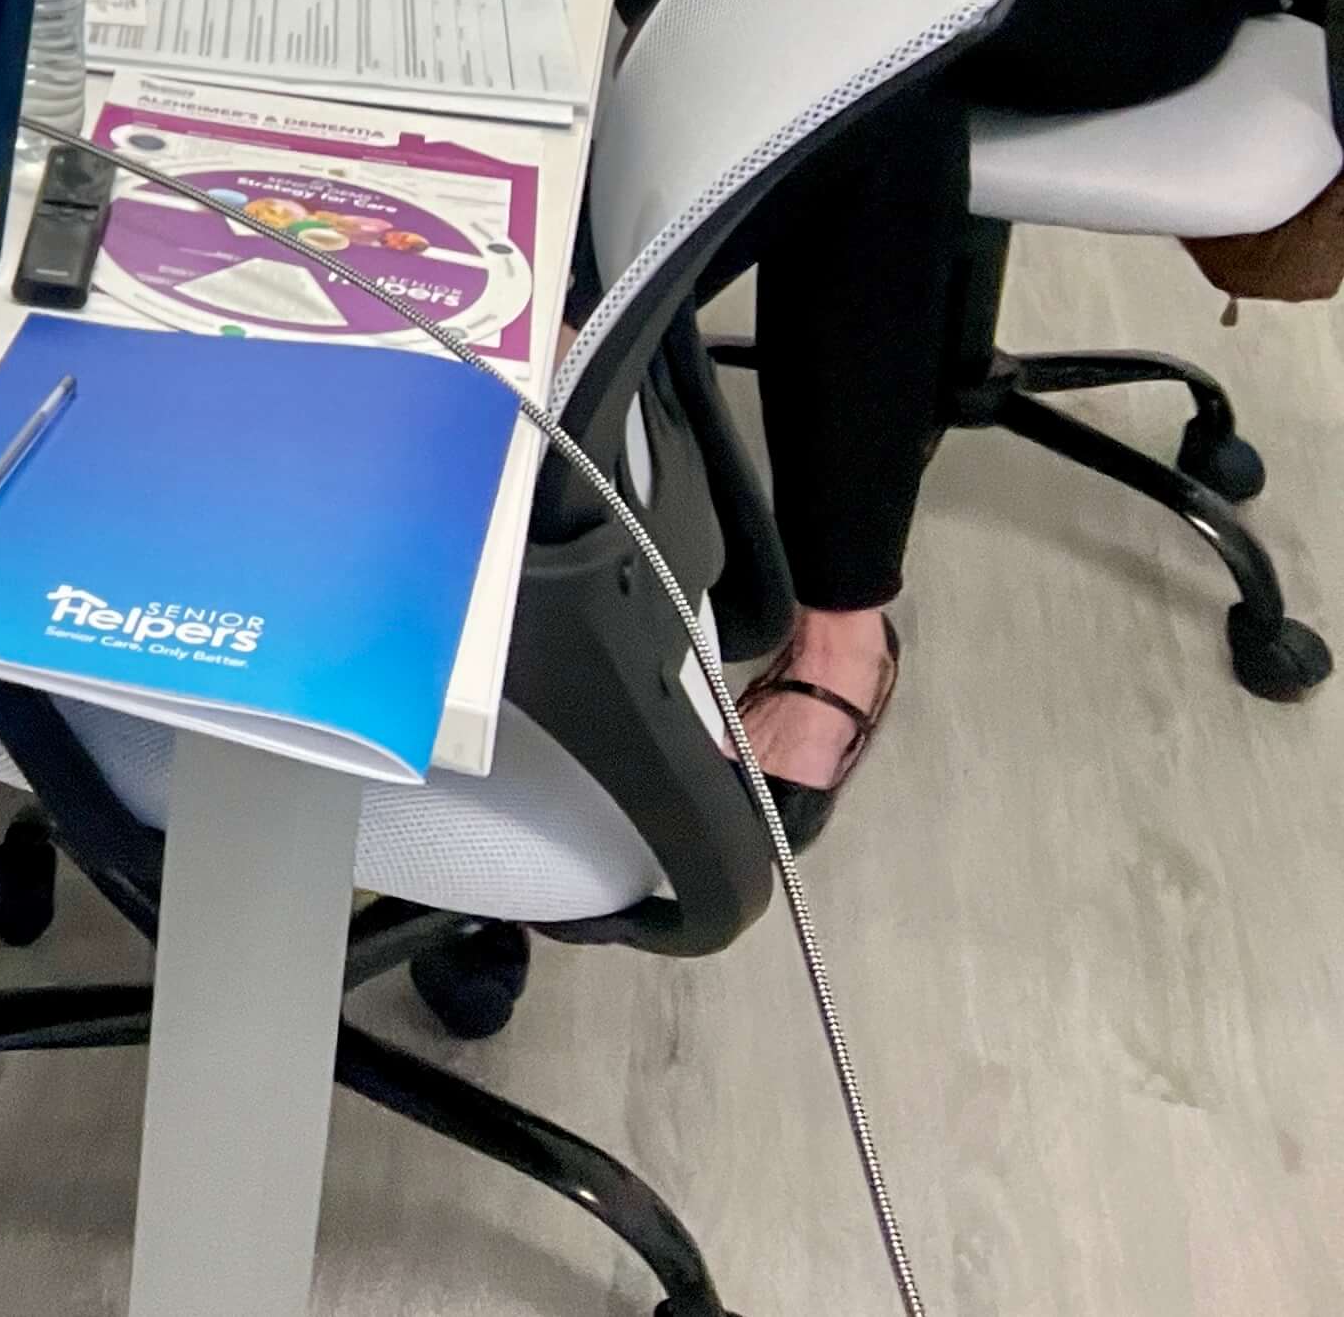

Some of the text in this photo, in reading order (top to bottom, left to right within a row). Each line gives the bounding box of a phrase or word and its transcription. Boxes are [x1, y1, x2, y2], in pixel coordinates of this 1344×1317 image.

[48, 588, 259, 653] Helpers
[146, 602, 265, 631] SENIOR
[44, 626, 96, 643] Senior
[148, 643, 190, 661] Only
